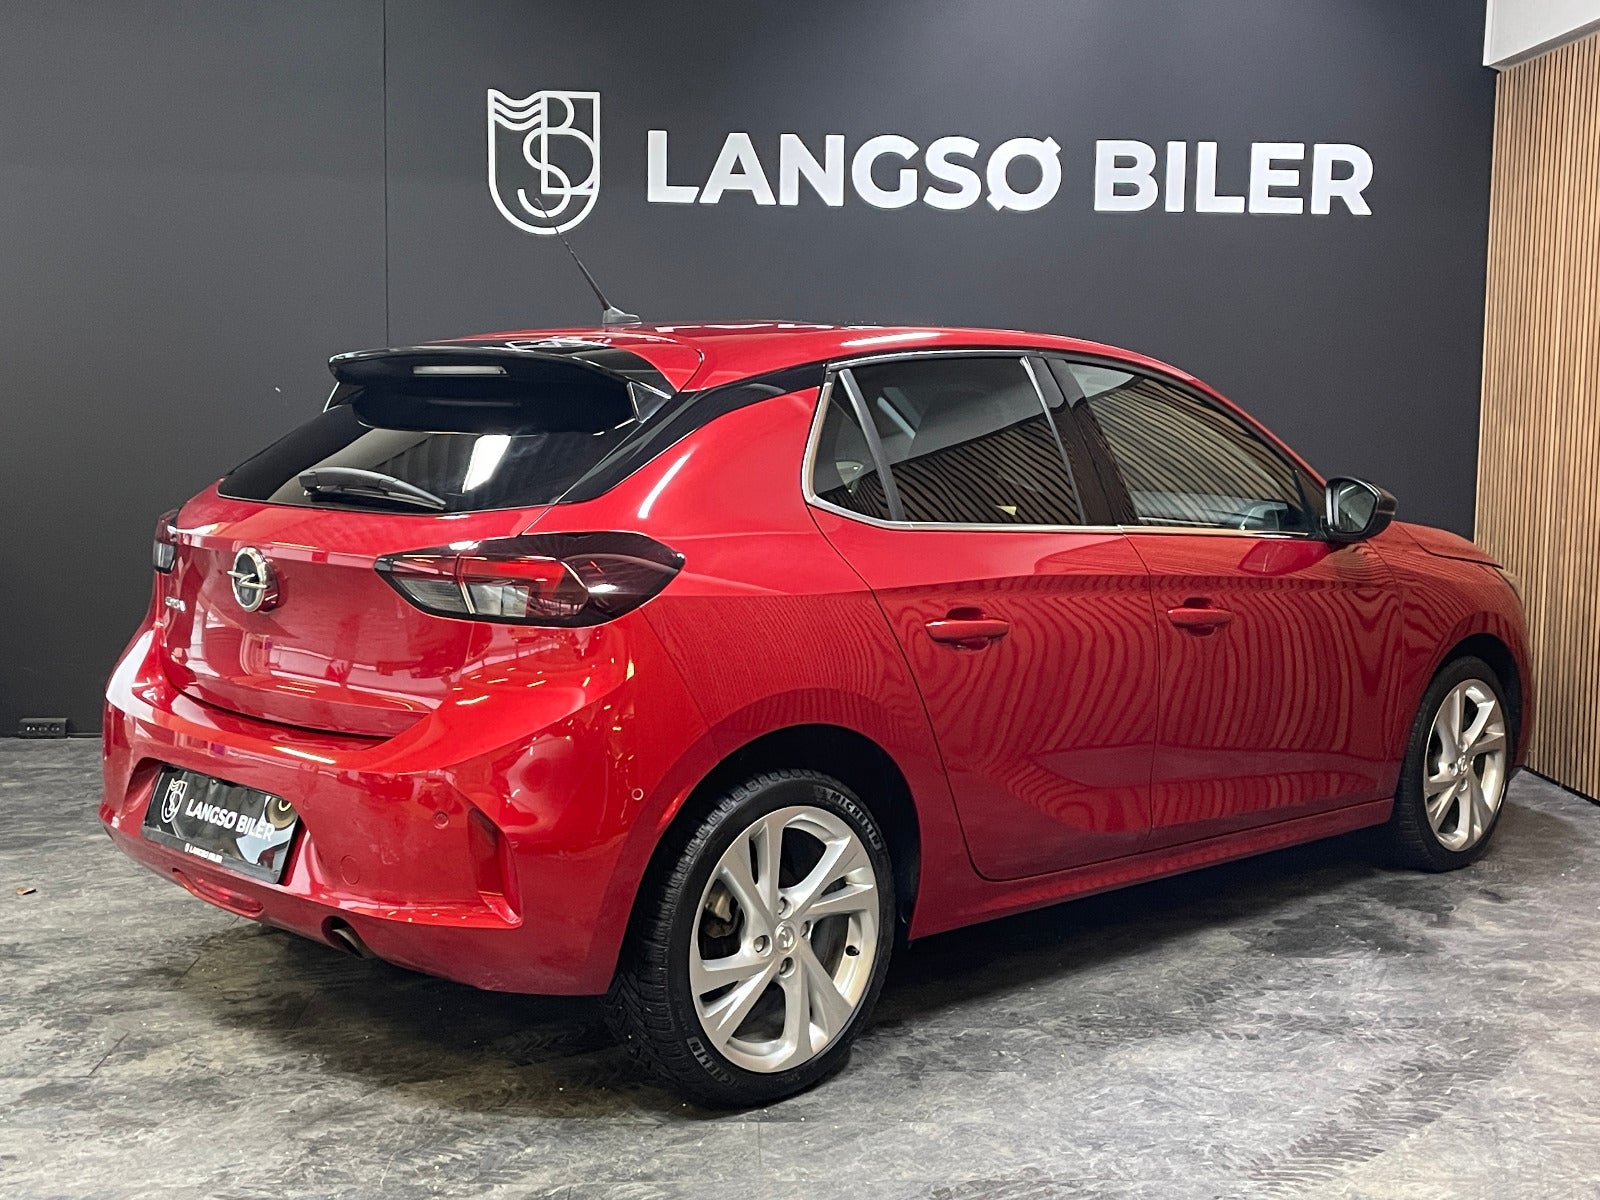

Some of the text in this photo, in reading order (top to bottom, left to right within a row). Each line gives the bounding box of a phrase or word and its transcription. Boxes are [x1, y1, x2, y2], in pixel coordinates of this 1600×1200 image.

[647, 130, 1062, 212] LANGSØ
[1094, 140, 1374, 216] BILER
[235, 814, 276, 842] BILER
